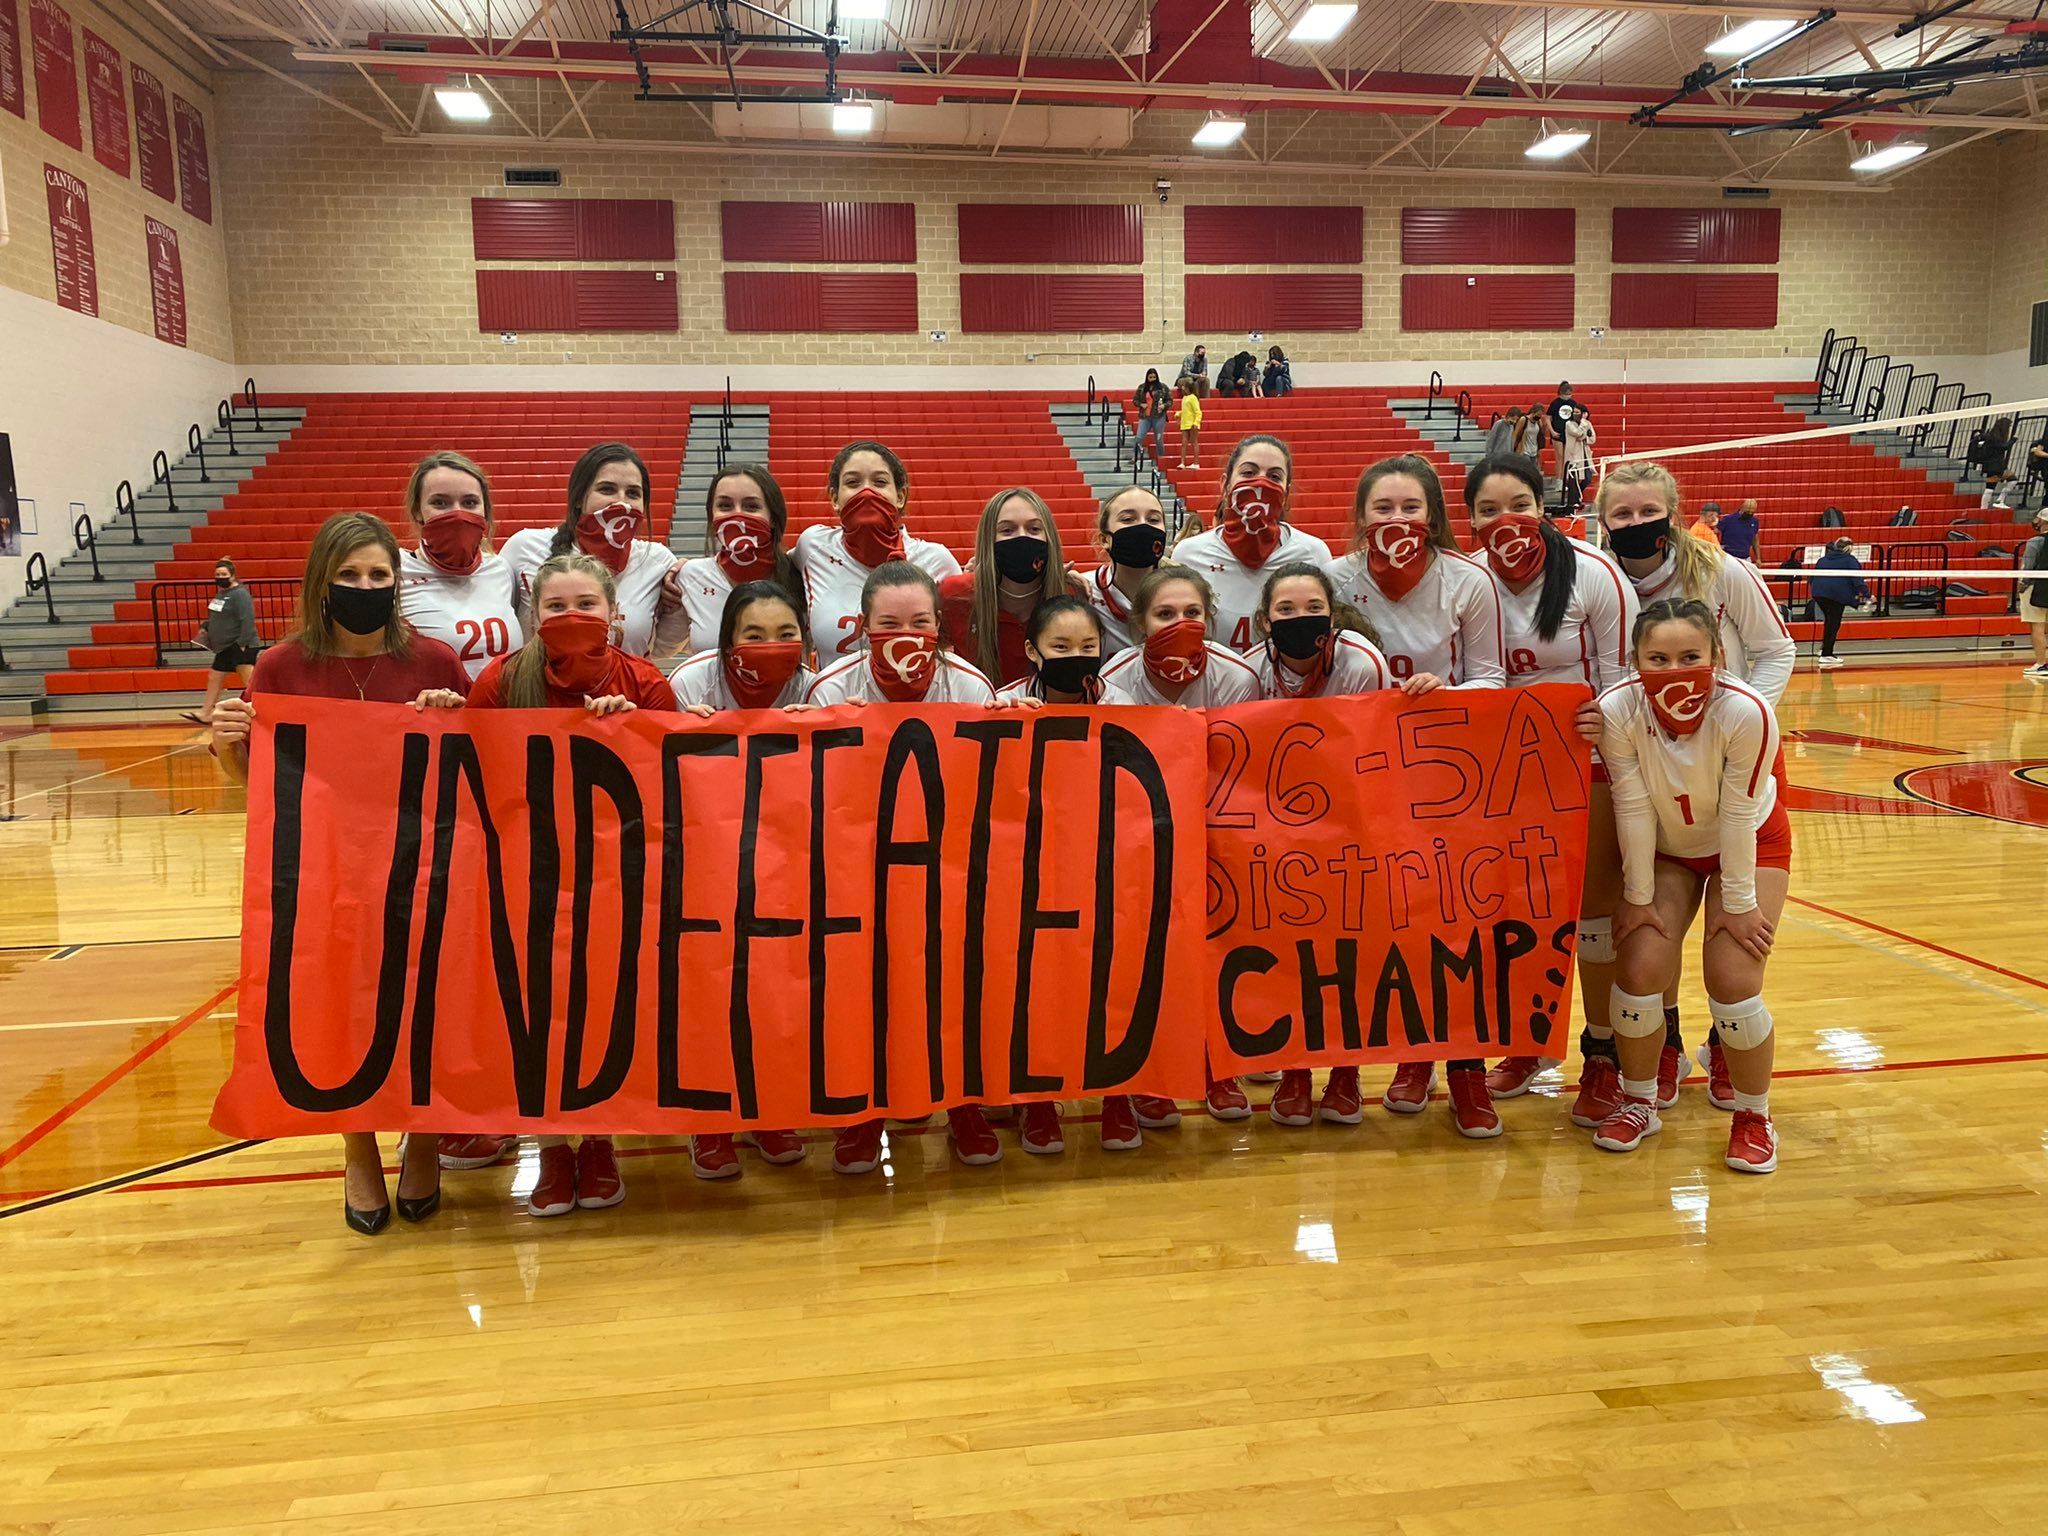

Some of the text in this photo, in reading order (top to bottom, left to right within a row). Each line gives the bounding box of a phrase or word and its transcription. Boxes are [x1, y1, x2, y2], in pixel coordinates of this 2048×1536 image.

[46, 169, 86, 202] CANYON
[146, 220, 177, 247] CANYON
[455, 617, 509, 661] 20
[1673, 793, 1695, 825] 1
[264, 716, 1174, 1119] UNDEFEATED
